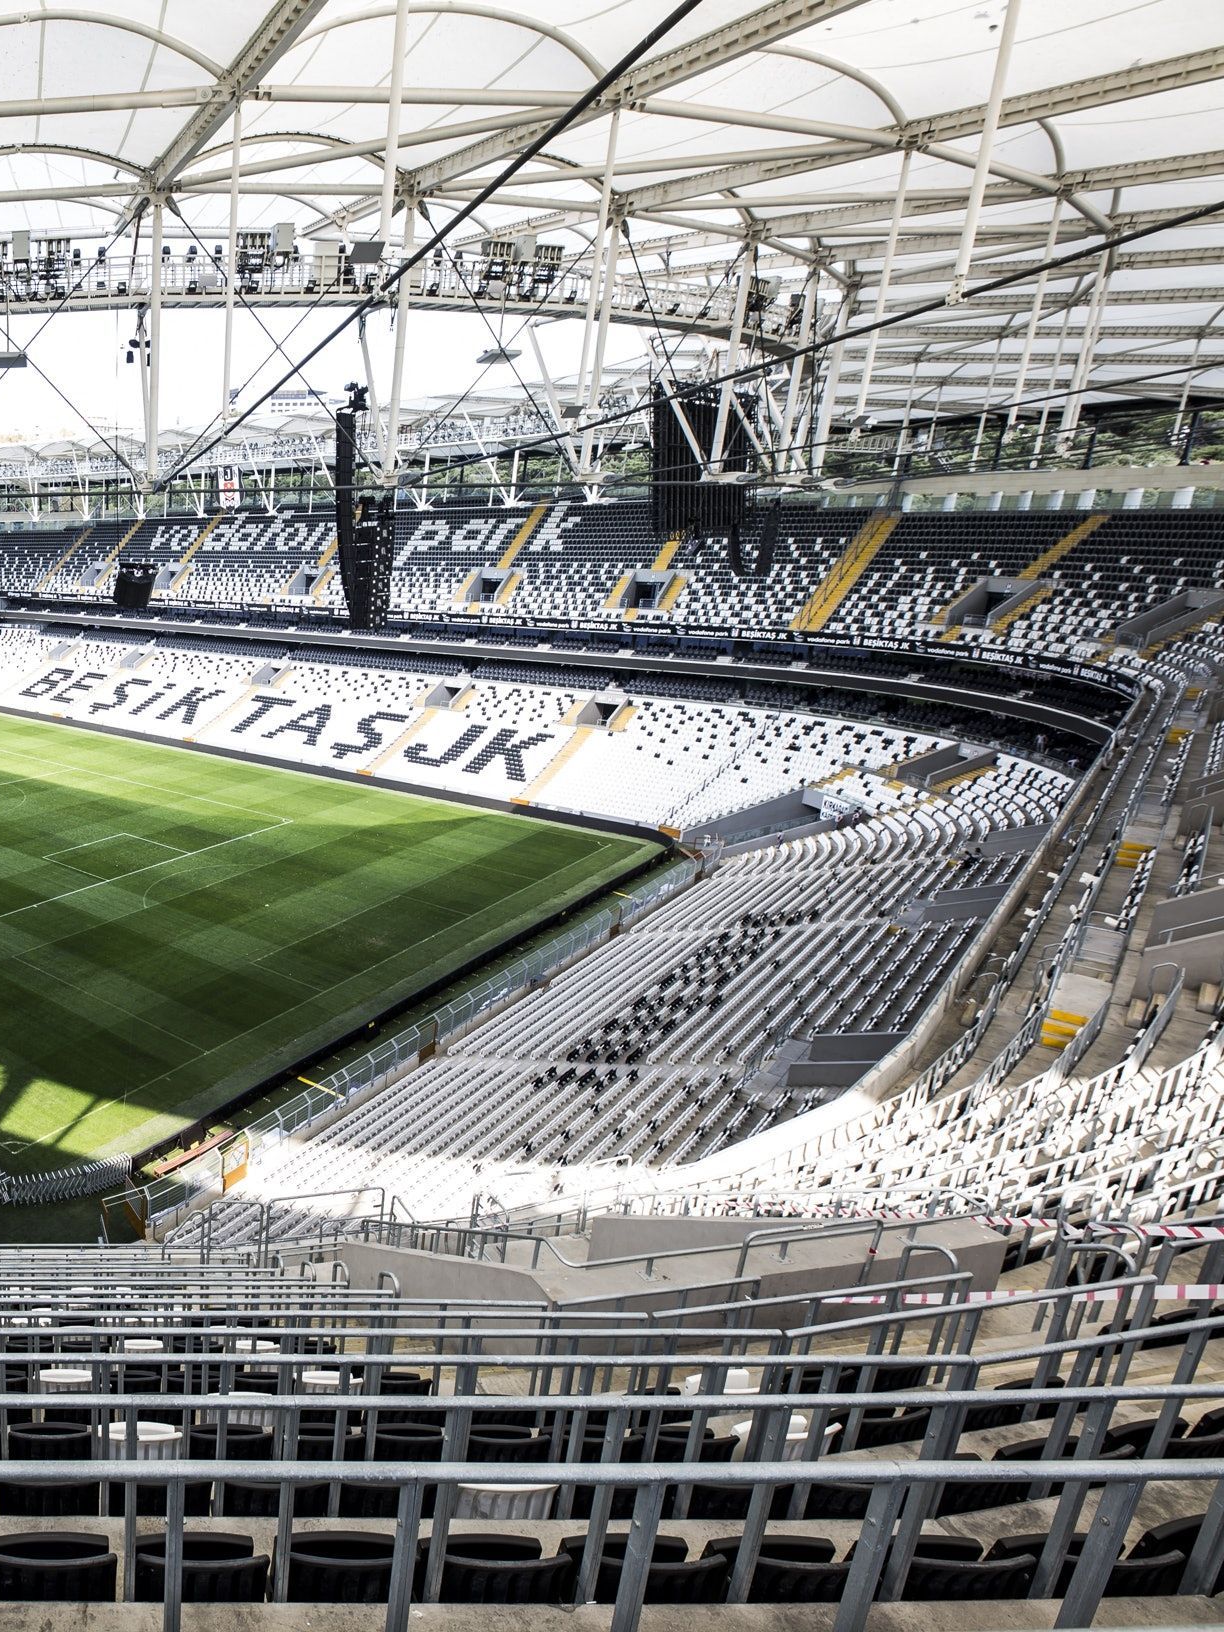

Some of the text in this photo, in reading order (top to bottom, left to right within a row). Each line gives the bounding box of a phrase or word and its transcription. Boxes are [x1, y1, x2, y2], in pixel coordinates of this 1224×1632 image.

[150, 501, 581, 567] vodafon park
[579, 621, 609, 631] BEŞİKTAŞ
[741, 630, 788, 640] BEŞİKTAŞ JK
[863, 638, 910, 650] BEŞİKTAŞ JK
[927, 647, 969, 658] vodafone park
[981, 650, 1024, 664] BEŞİKTAŞ JK
[404, 724, 556, 782] JK
